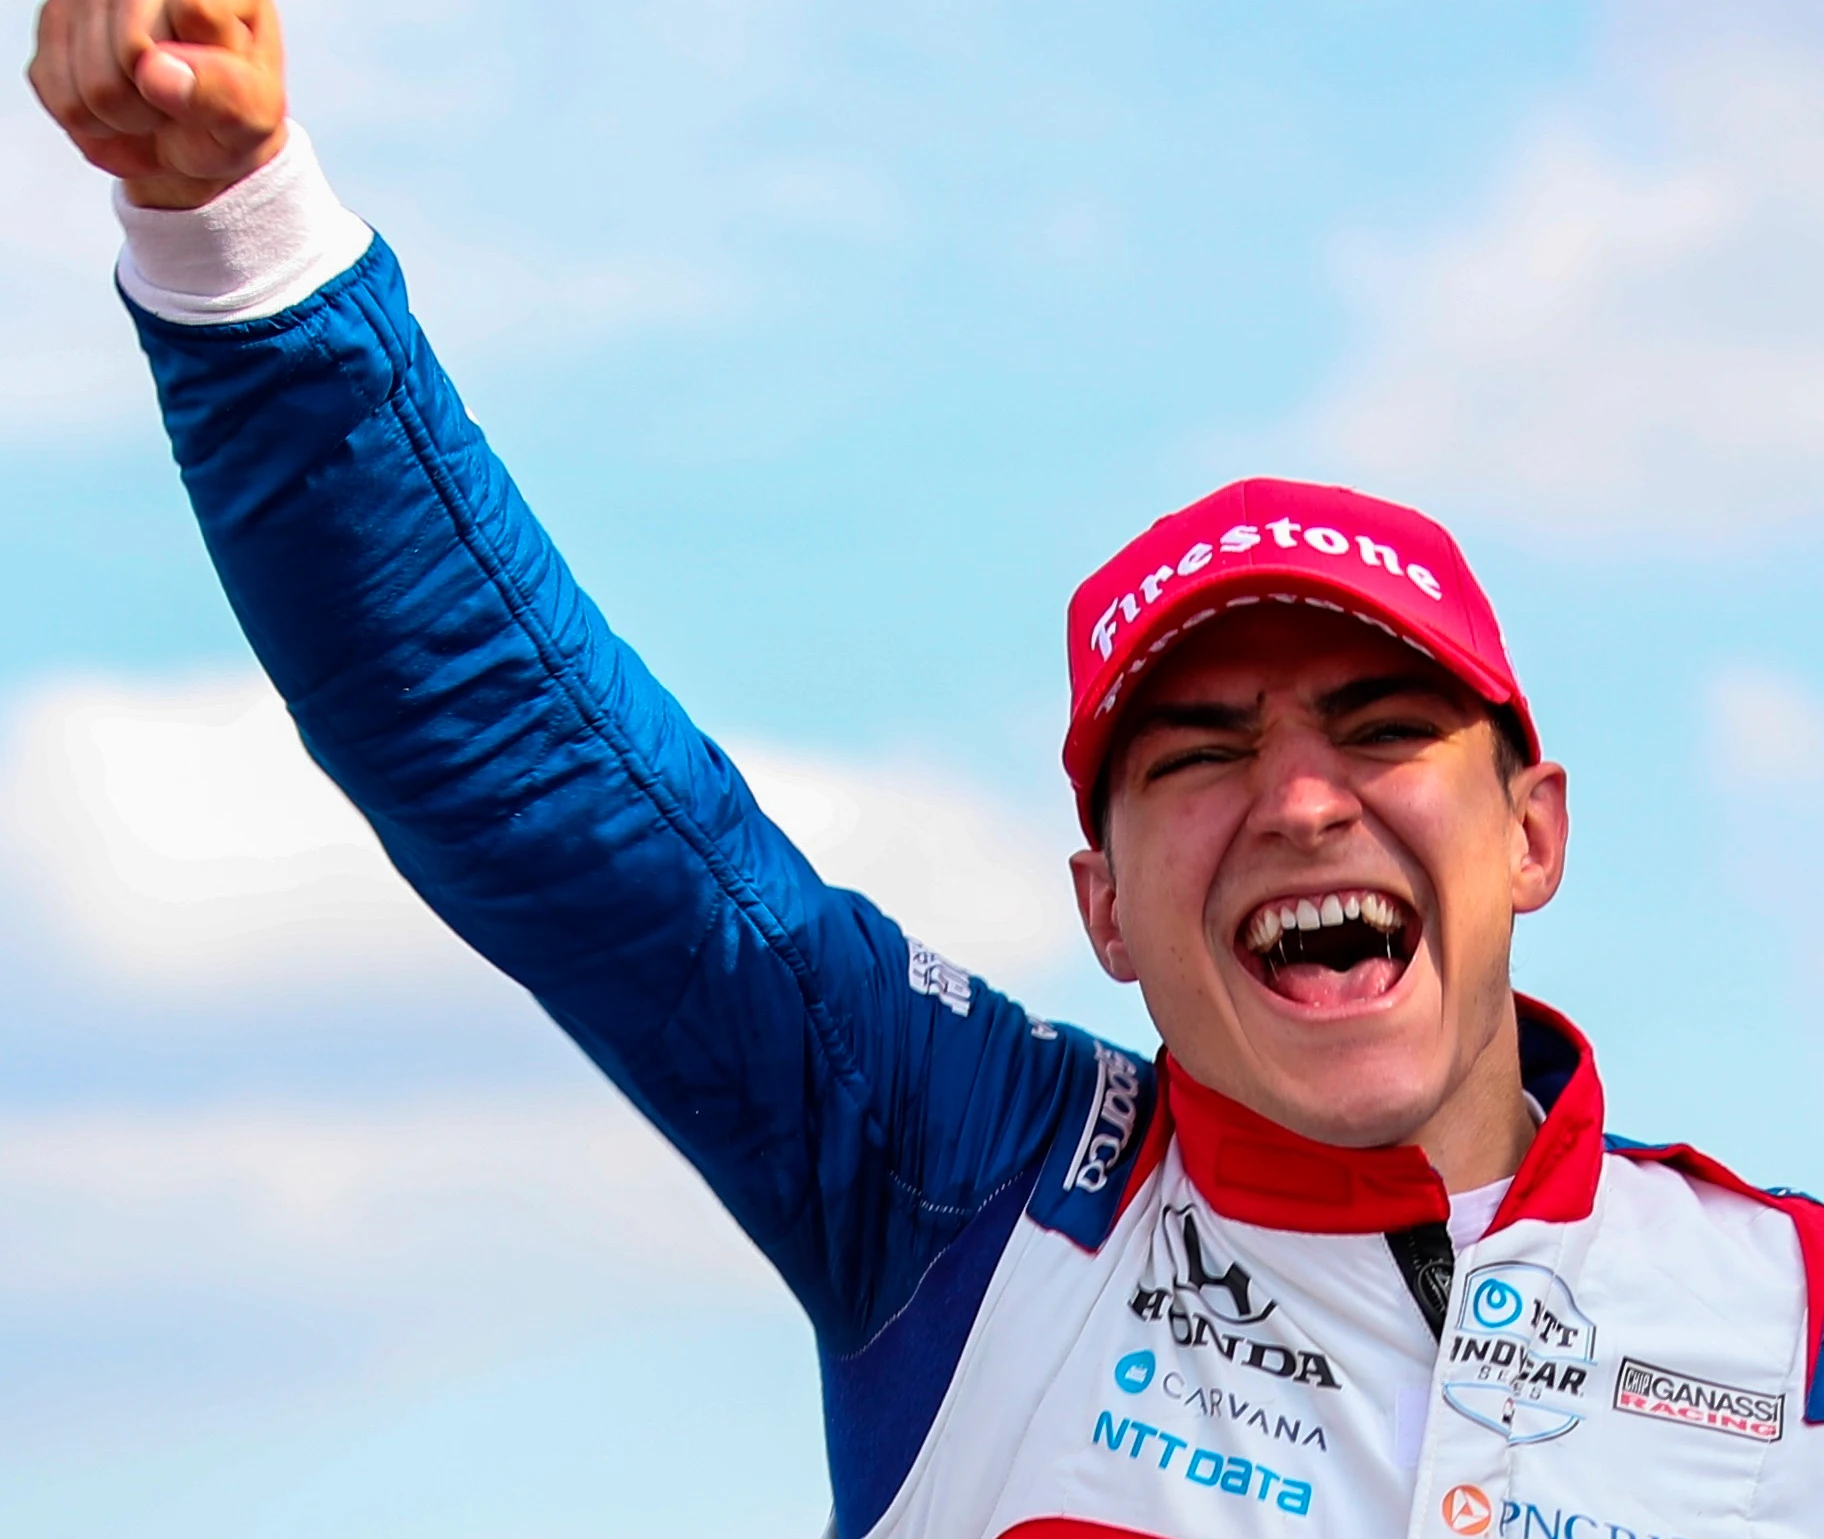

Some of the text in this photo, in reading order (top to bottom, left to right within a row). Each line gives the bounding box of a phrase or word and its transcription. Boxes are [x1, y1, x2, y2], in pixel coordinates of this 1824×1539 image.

[1090, 515, 1442, 662] Firestone
[1128, 1281, 1343, 1391] HONDA
[1162, 1371, 1327, 1452] CARVANA
[1620, 1392, 1777, 1437] RACING
[1625, 1368, 1779, 1423] CHIP GANASSI
[1092, 1409, 1188, 1471] NTT
